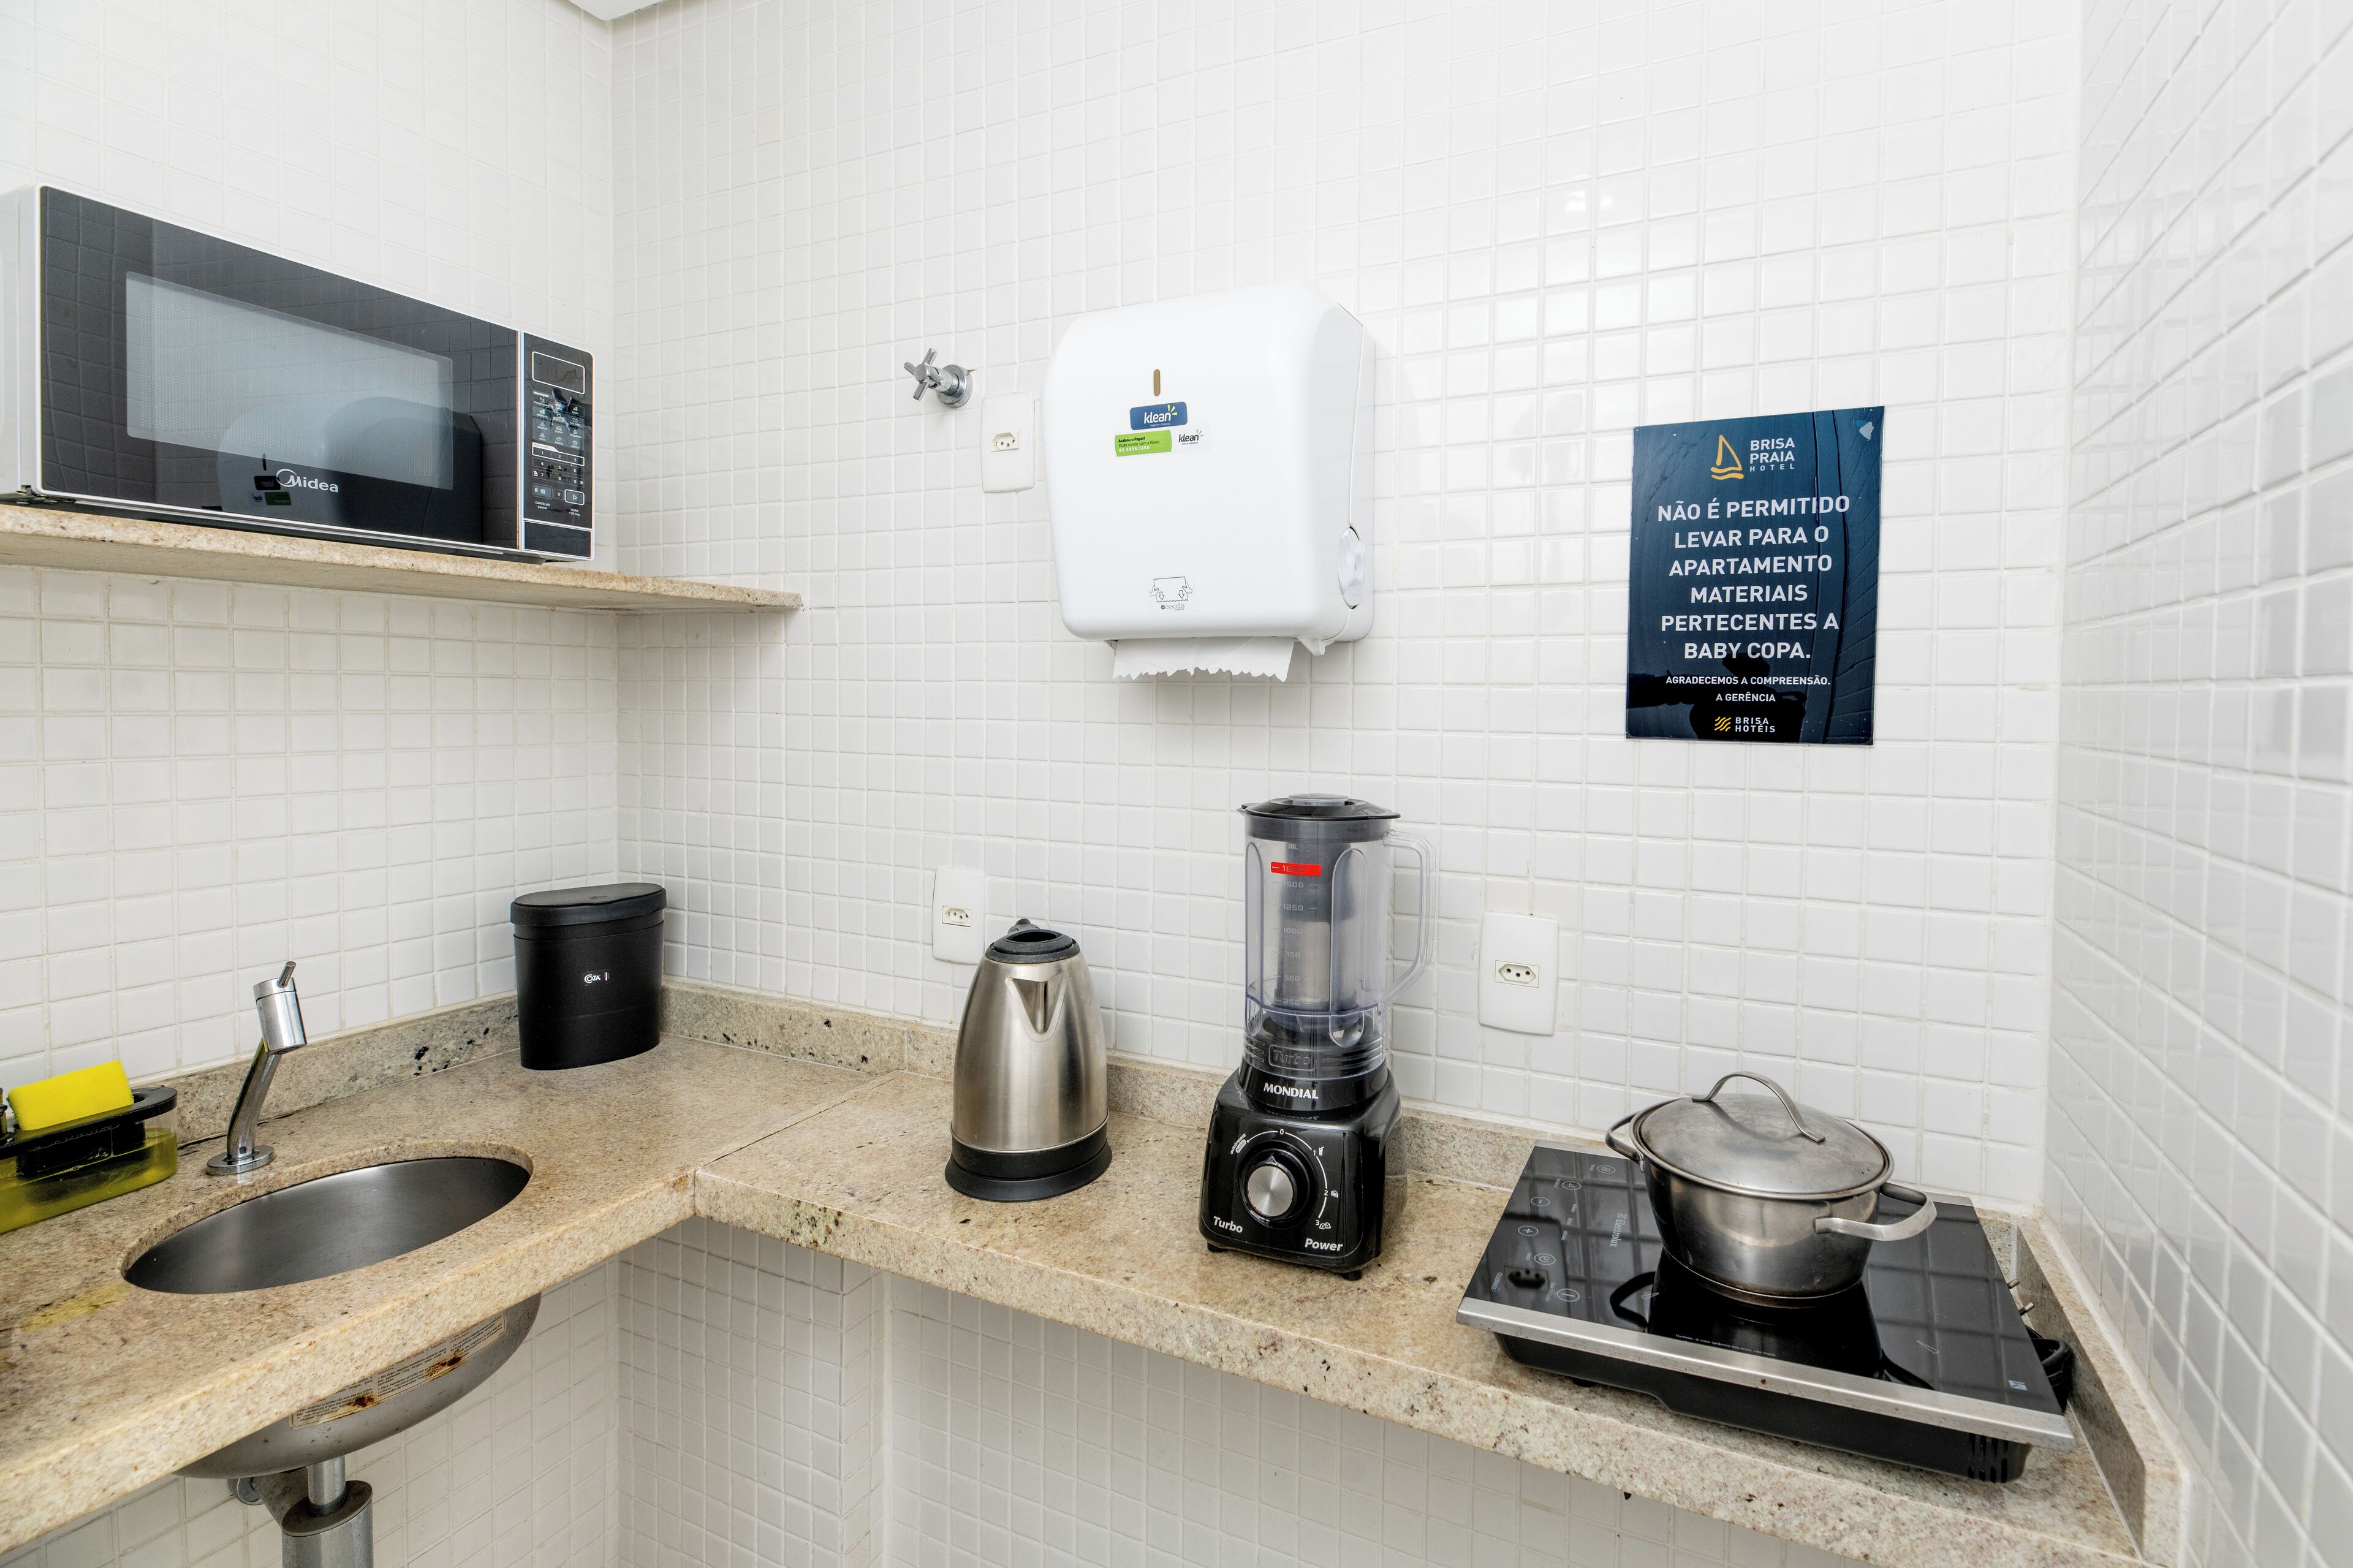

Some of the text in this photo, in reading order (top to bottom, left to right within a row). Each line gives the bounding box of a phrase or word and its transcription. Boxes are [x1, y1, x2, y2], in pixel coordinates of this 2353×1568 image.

[1143, 411, 1171, 424] klean
[1178, 433, 1199, 442] klean
[1750, 437, 1795, 451] BRISA
[1750, 451, 1795, 464] PRAIA
[1749, 463, 1795, 472] HOTEL
[276, 469, 338, 493] Midea
[1658, 495, 1850, 521] NÃO É PERMITIDO
[1675, 526, 1828, 548] LEVAR PARA O
[1669, 555, 1832, 576] APARTAMENTO
[1691, 585, 1808, 603] MATERIAIS
[1661, 613, 1840, 632] PERTECENTES A
[1684, 642, 1811, 659] BABY COPA.
[1665, 675, 1831, 685] AGRADECEMOS A COMPREENSÃO.
[1724, 691, 1776, 702] GERÊNCIA
[1735, 723, 1776, 733] HOTÉIS
[1283, 903, 1303, 912] 1250
[585, 974, 601, 983] COZA
[1273, 1049, 1311, 1065] Turbo
[1264, 1082, 1319, 1099] MONDIAL
[1213, 1216, 1243, 1233] Turbo
[1610, 1220, 1625, 1248] Electrolux
[1305, 1238, 1343, 1251] Power
[395, 1373, 423, 1387] recomendamos
[377, 1388, 396, 1397] removedor
[402, 1379, 417, 1387] manchas
